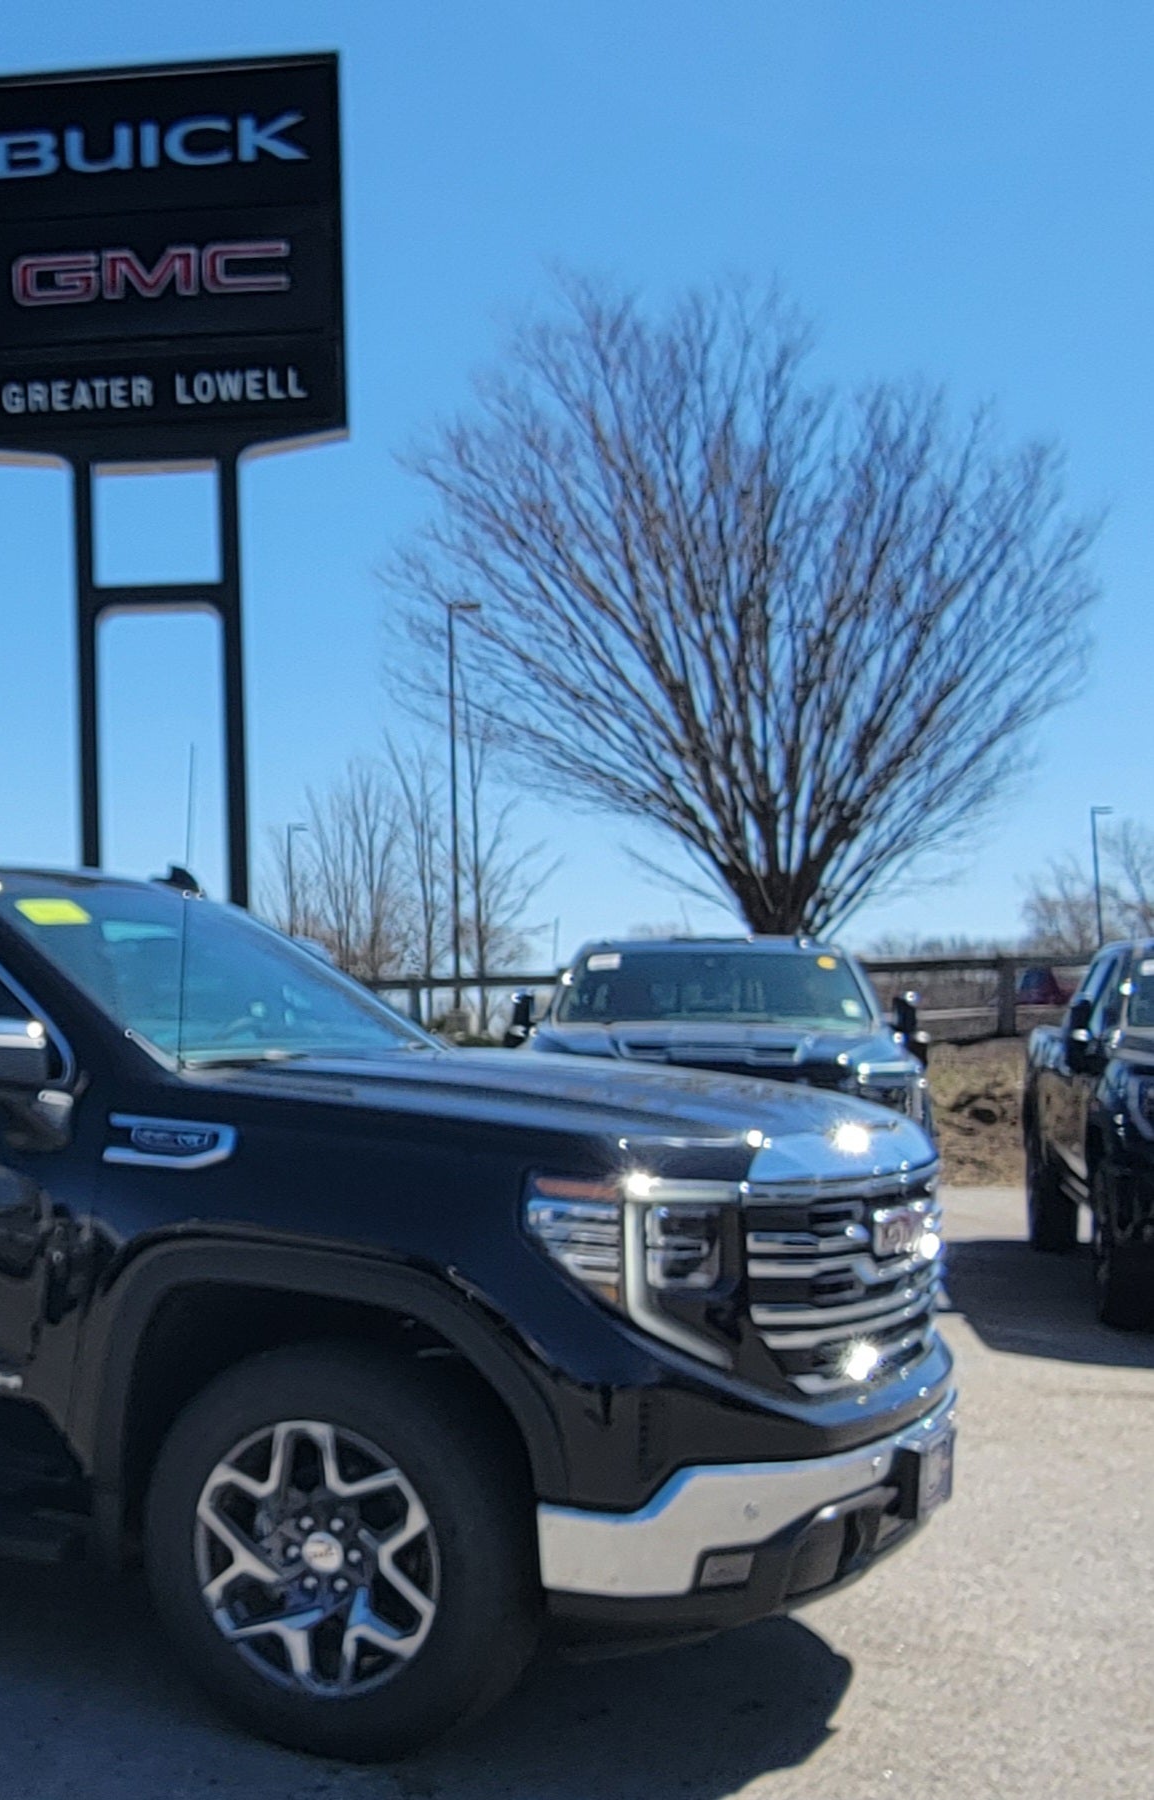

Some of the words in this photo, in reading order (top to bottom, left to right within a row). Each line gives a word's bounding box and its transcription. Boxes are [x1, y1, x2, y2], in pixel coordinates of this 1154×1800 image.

[12, 238, 291, 307] GMC
[1, 375, 154, 414] GREATER
[175, 366, 308, 405] LOWELL
